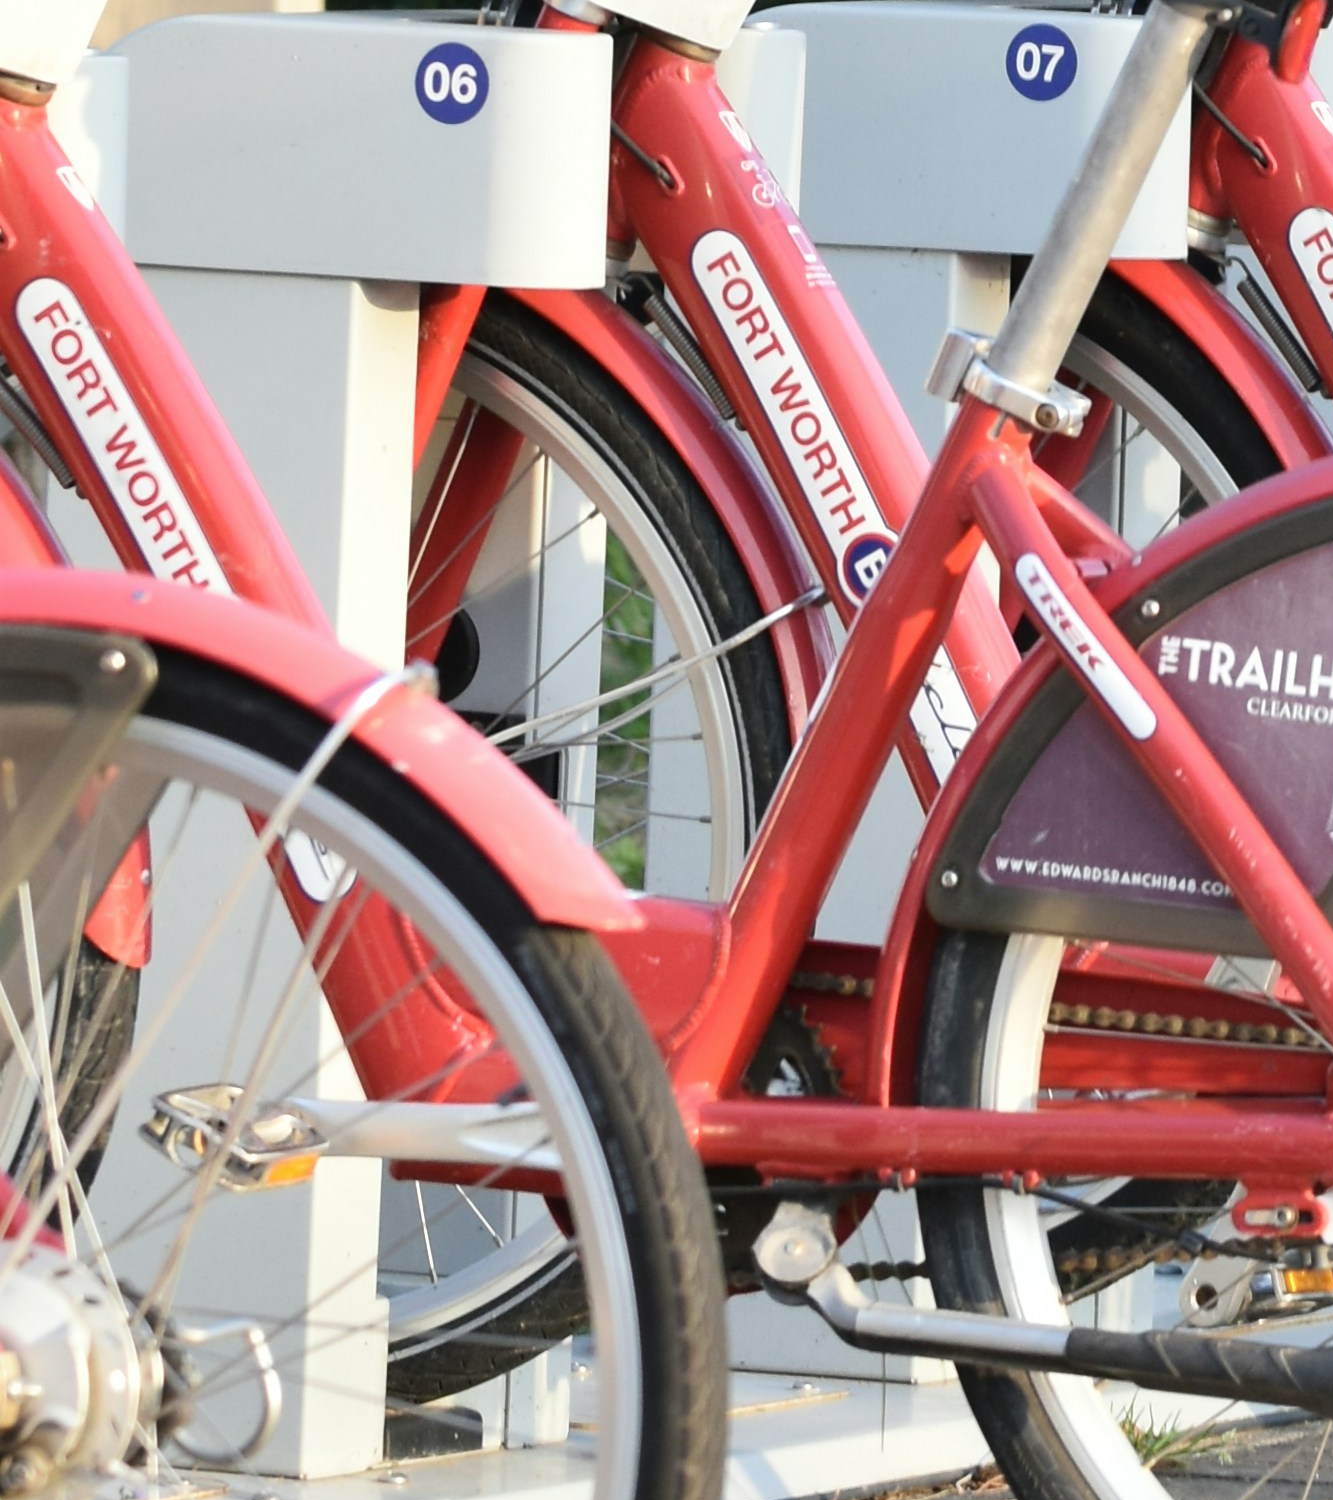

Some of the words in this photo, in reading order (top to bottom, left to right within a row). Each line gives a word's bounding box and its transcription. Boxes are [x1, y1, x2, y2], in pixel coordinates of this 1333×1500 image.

[423, 62, 479, 104] 06
[1014, 43, 1065, 83] 07
[707, 251, 785, 361] FORT
[770, 367, 866, 535] WORTH
[33, 300, 118, 418] FORT
[105, 423, 210, 589] WORTH
[1028, 565, 1106, 673] TREK
[1158, 635, 1181, 676] THE
